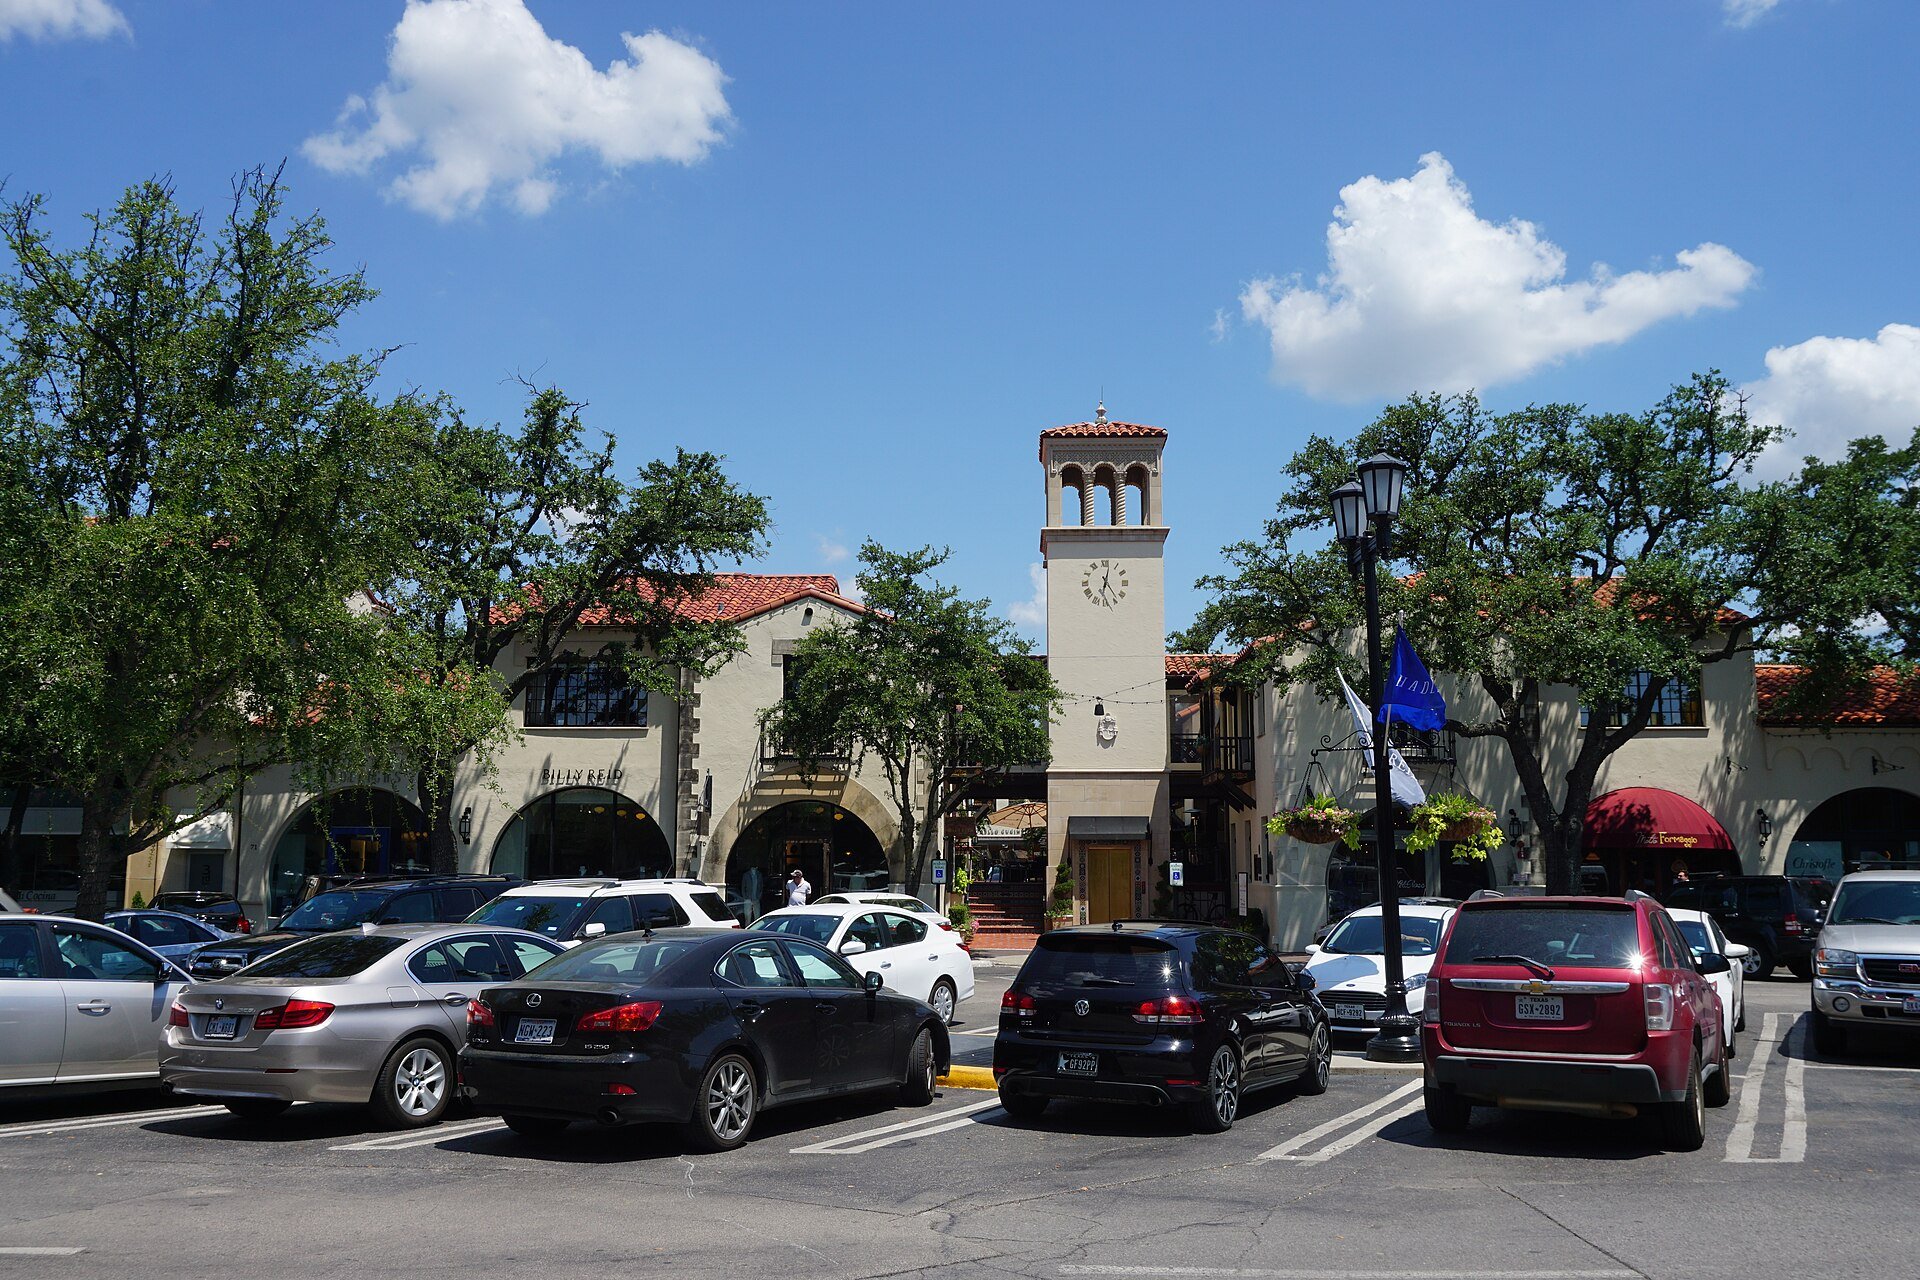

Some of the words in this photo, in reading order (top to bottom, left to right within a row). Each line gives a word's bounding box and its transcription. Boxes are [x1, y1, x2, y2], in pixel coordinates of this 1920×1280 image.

[543, 769, 583, 780] BILLY
[588, 769, 623, 780] REID
[1658, 831, 1698, 848] Formaggio
[1793, 857, 1836, 871] Christofle
